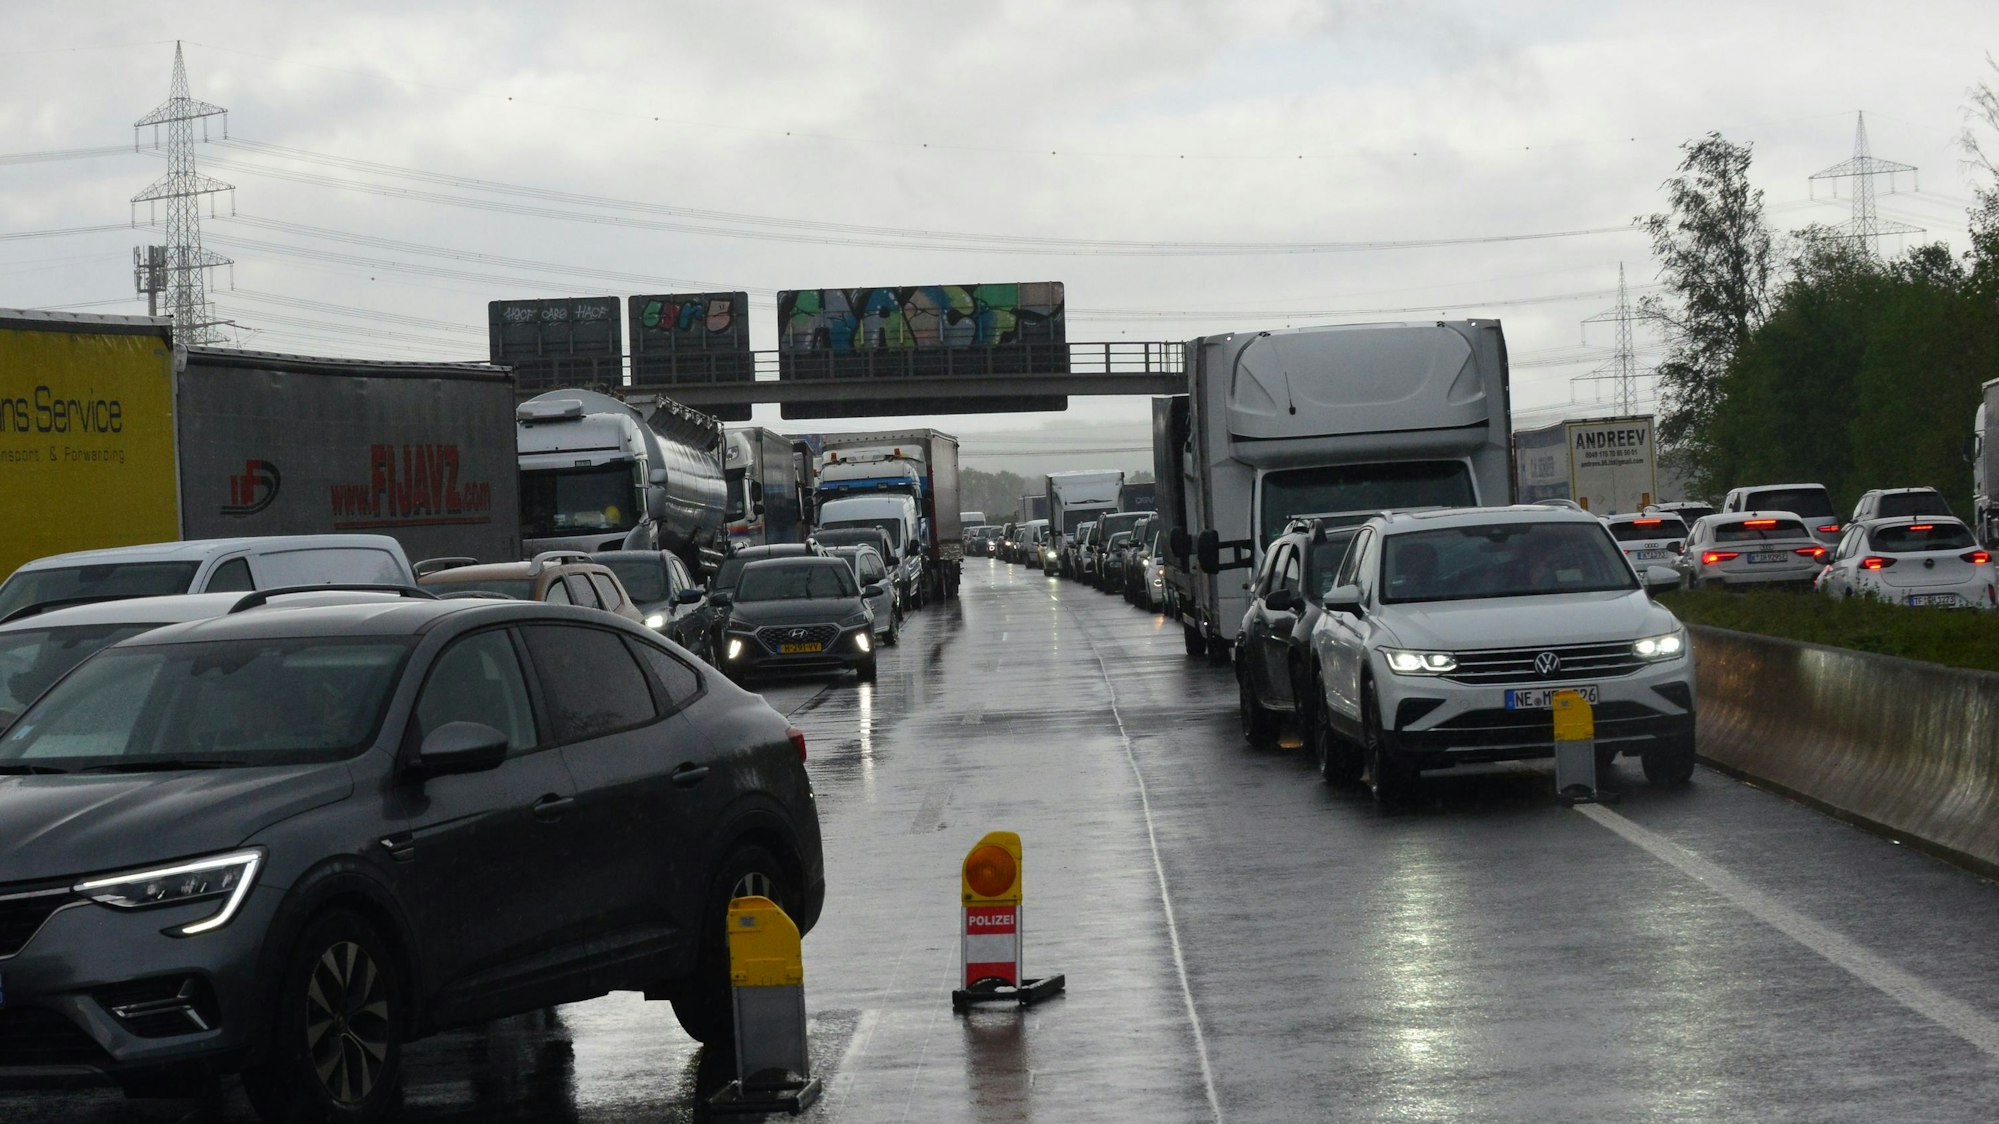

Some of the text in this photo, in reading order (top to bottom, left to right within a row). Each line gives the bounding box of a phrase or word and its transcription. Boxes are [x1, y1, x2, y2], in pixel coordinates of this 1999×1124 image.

[35, 385, 123, 433] Service
[1576, 429, 1646, 449] ANDREEV
[50, 446, 58, 461] &
[64, 446, 126, 464] Forwarding
[330, 443, 491, 517] www.FIJAVZ.com
[1515, 692, 1532, 707] NE
[969, 915, 1015, 926] POLIZEI
